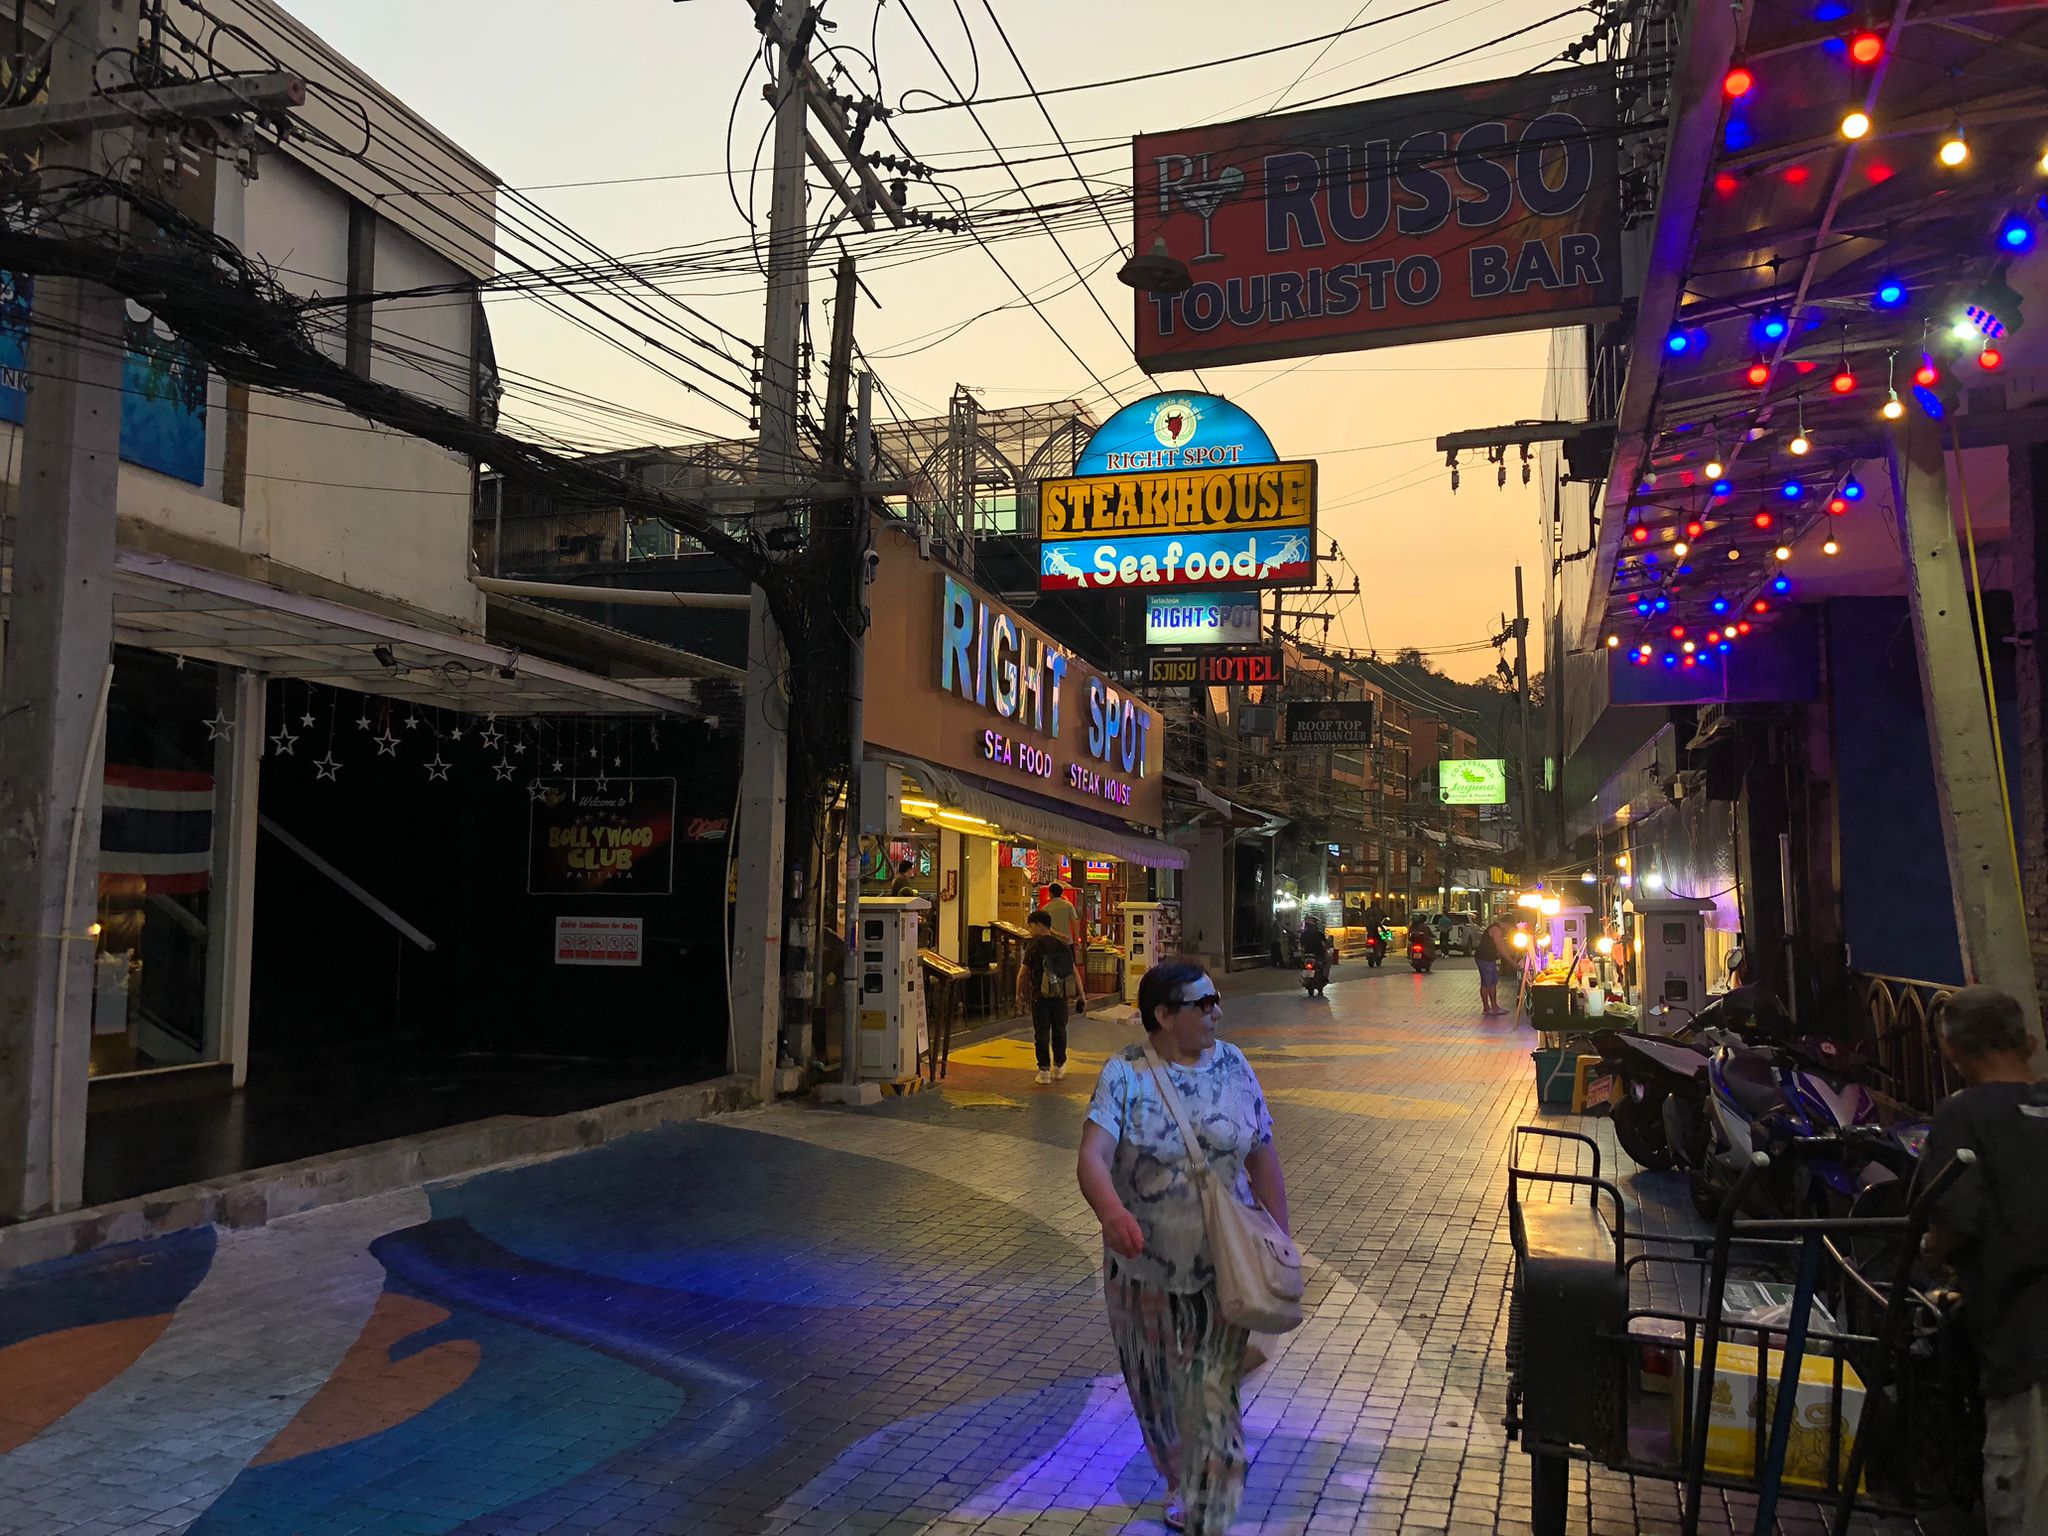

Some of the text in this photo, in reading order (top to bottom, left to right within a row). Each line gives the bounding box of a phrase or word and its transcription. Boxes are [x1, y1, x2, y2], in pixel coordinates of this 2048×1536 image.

[1264, 112, 1593, 252] RUSSO
[1148, 232, 1603, 336] TOURISTO BAR
[1106, 444, 1244, 471] RIGHT SPOT
[1093, 537, 1257, 586] Seafood
[1151, 605, 1254, 628] RIGHT SPOT
[940, 572, 1150, 779] RIGHT SPOT
[1200, 657, 1280, 681] HOTEL
[1298, 720, 1362, 731] ROOF TOP
[1314, 731, 1343, 741] INDIAN
[1344, 731, 1366, 741] CLUB
[984, 729, 1053, 779] SEA FOOD
[1070, 762, 1132, 806] STEAK HOUSE
[578, 795, 617, 807] Welcome
[548, 825, 653, 848] BOLLYWOOD
[567, 848, 633, 870] CLUB
[566, 871, 633, 879] PATTAYA
